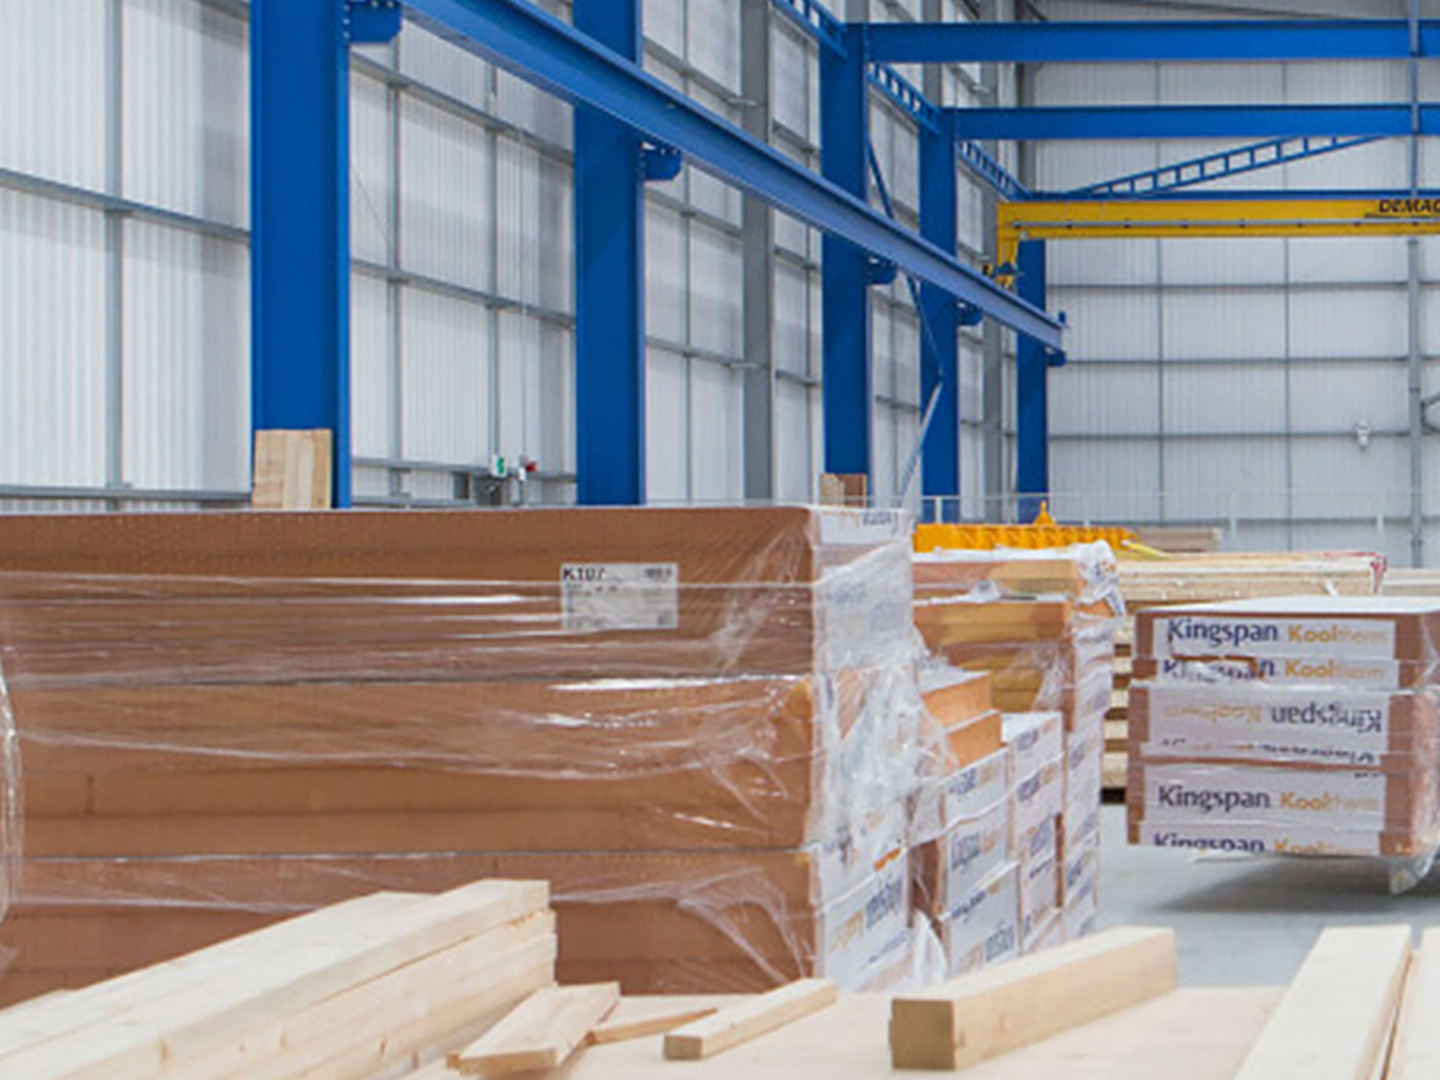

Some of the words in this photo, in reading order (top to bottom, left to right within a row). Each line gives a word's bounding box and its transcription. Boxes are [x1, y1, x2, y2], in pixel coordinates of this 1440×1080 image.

[1168, 617, 1278, 648] Kingspan
[1271, 701, 1382, 734] Kingspan
[1159, 784, 1271, 814] Kingspan
